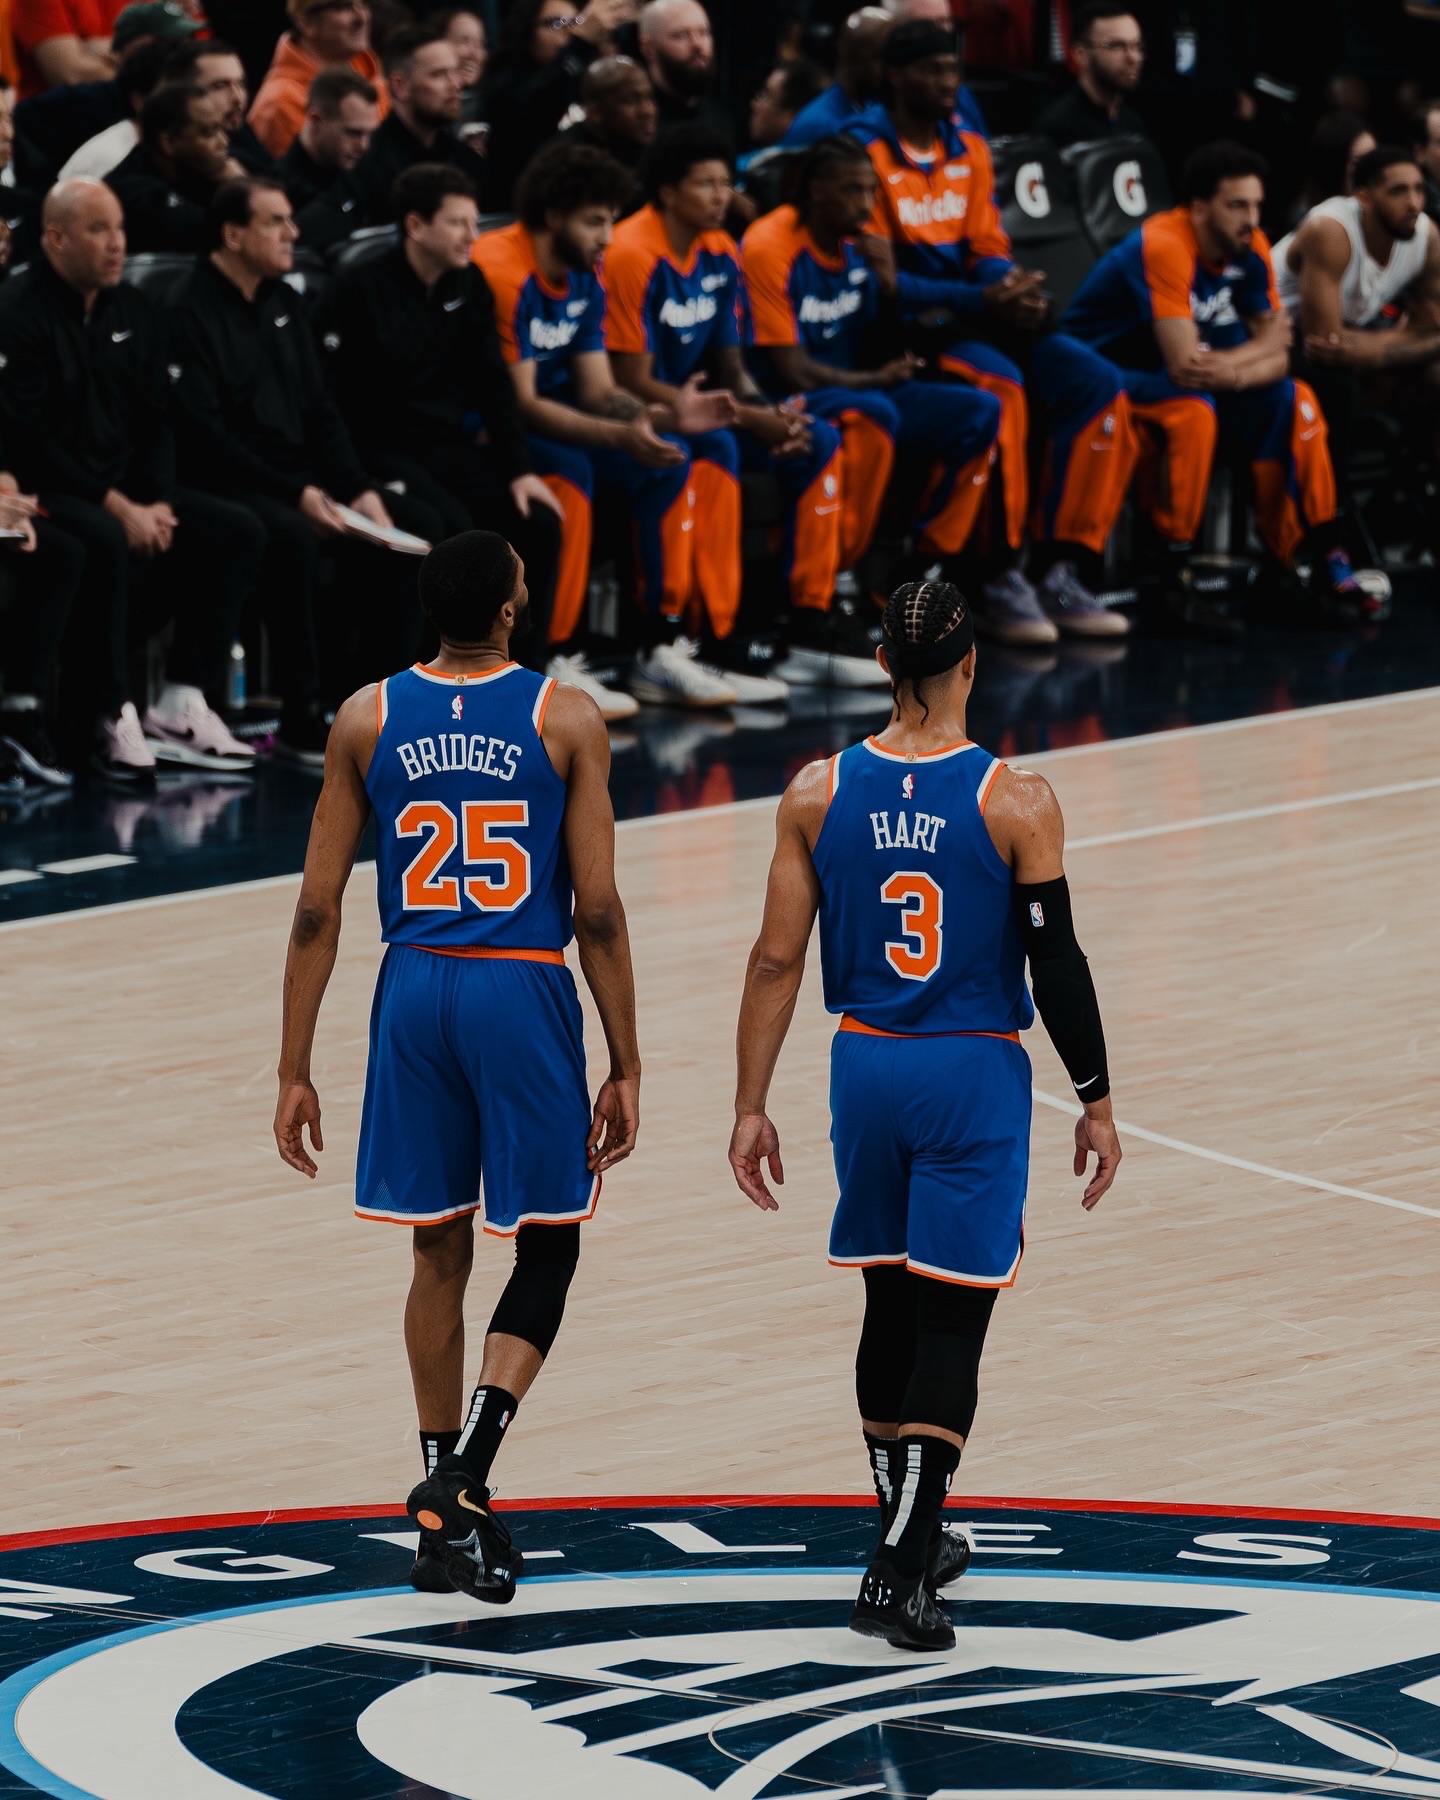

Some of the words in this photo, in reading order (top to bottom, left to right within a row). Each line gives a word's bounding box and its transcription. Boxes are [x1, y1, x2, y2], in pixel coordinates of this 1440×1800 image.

[1015, 161, 1049, 218] G
[1113, 160, 1147, 217] G
[396, 733, 523, 782] BRIDGES
[395, 800, 531, 912] 25
[869, 811, 946, 853] HART
[880, 871, 943, 982] 3
